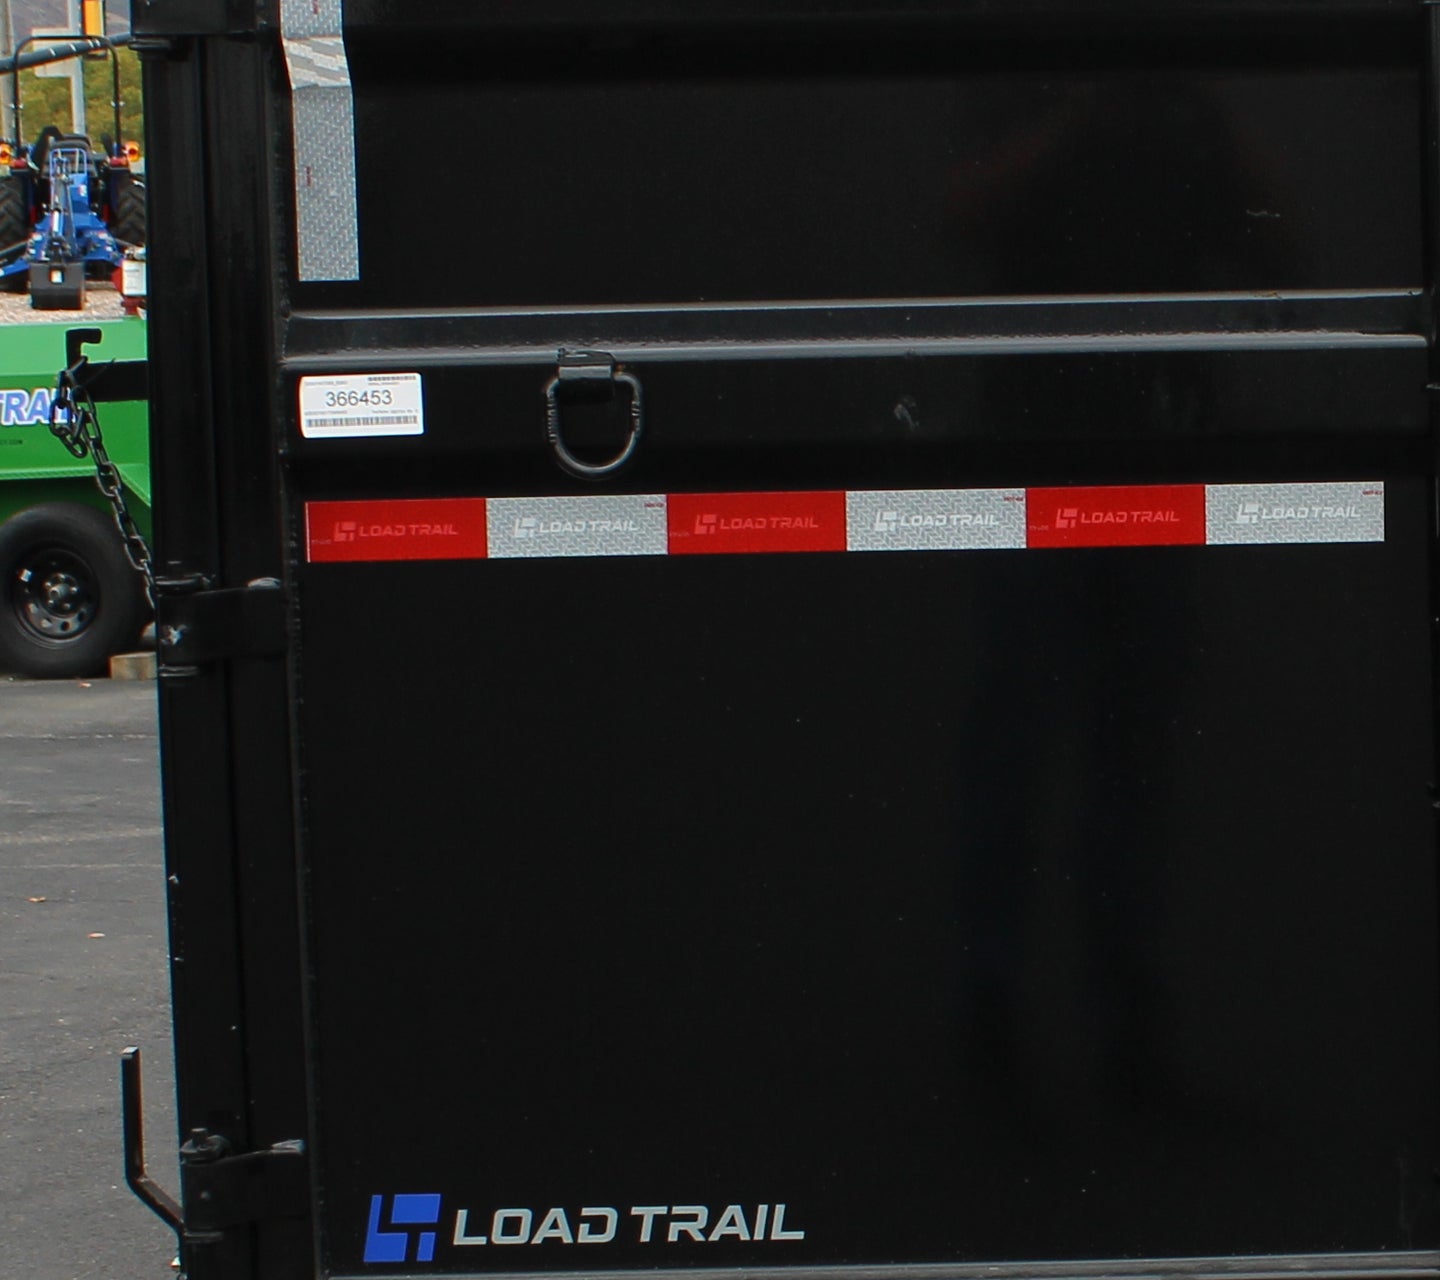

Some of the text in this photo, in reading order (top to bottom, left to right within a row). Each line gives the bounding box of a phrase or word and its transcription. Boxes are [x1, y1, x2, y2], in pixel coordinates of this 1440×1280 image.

[326, 389, 392, 407] 366453
[1081, 510, 1180, 523] LOAD TRAIL
[1262, 506, 1361, 519] LOAD TRAIL
[359, 523, 458, 537] LOAD TRAIL
[539, 518, 638, 533] LOAD TRAIL
[453, 1204, 805, 1246] LOAD TRAIL
